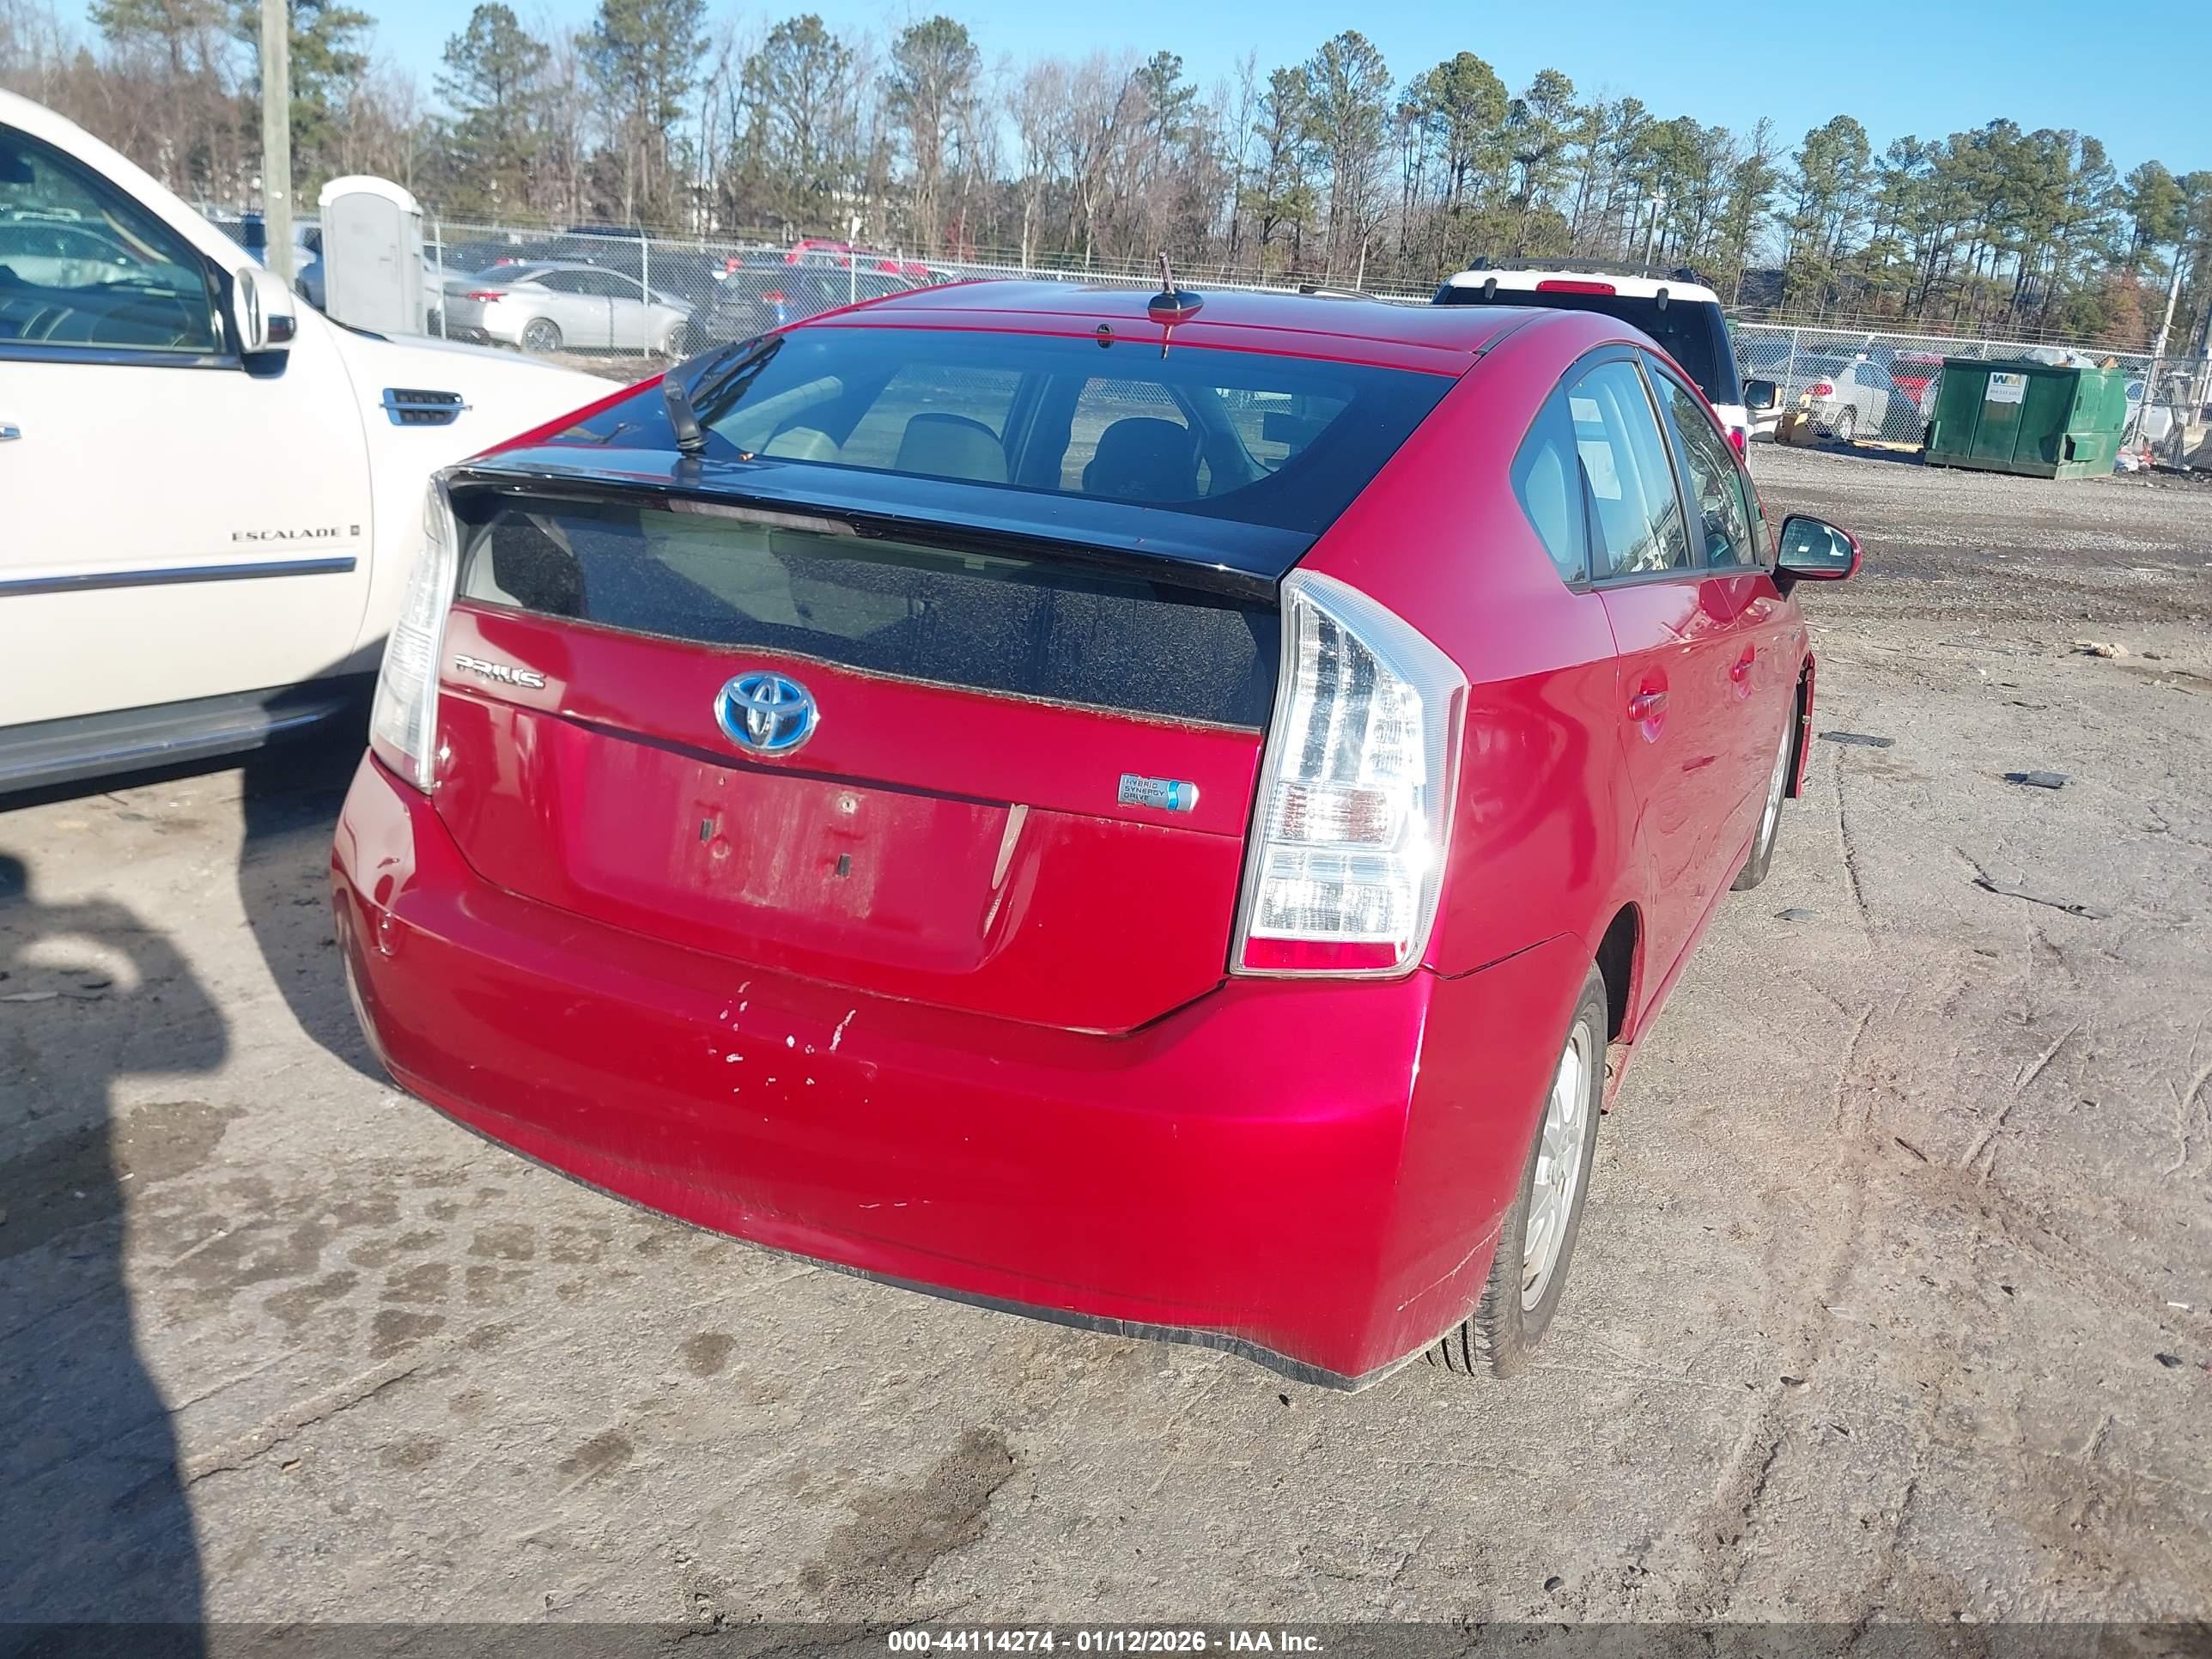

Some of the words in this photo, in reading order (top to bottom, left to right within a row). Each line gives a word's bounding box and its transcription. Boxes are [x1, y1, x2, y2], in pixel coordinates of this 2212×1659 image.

[1993, 374, 2021, 386] WM
[232, 527, 341, 542] ESCALADE
[453, 653, 546, 690] PRIUS
[1124, 778, 1158, 789] HYBRID
[1123, 792, 1150, 801] DRIVE
[1124, 786, 1165, 797] SYNERGY
